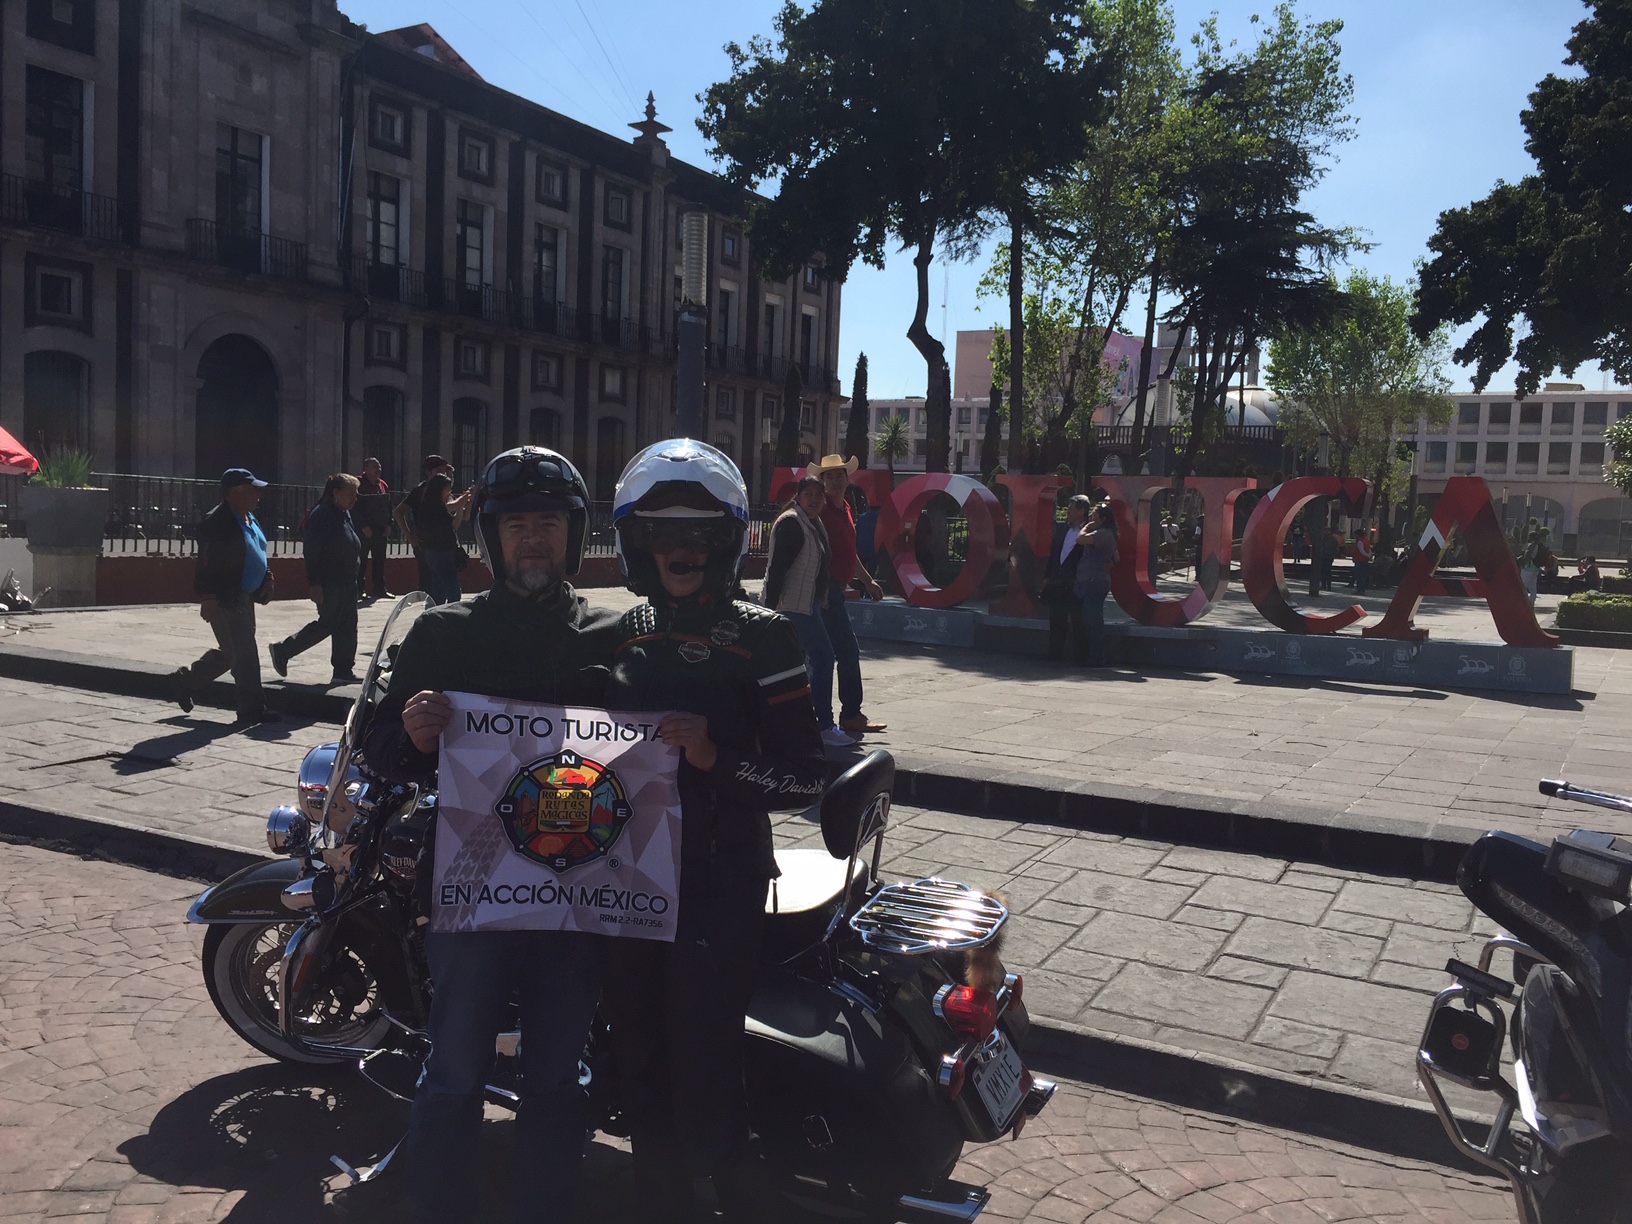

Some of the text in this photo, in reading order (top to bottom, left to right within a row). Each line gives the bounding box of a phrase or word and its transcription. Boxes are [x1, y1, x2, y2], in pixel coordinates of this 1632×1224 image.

[466, 711, 554, 739] MOTO
[561, 754, 576, 765] N
[735, 761, 778, 794] Harley
[439, 879, 669, 915] EN ACCIÓN MÉXICO
